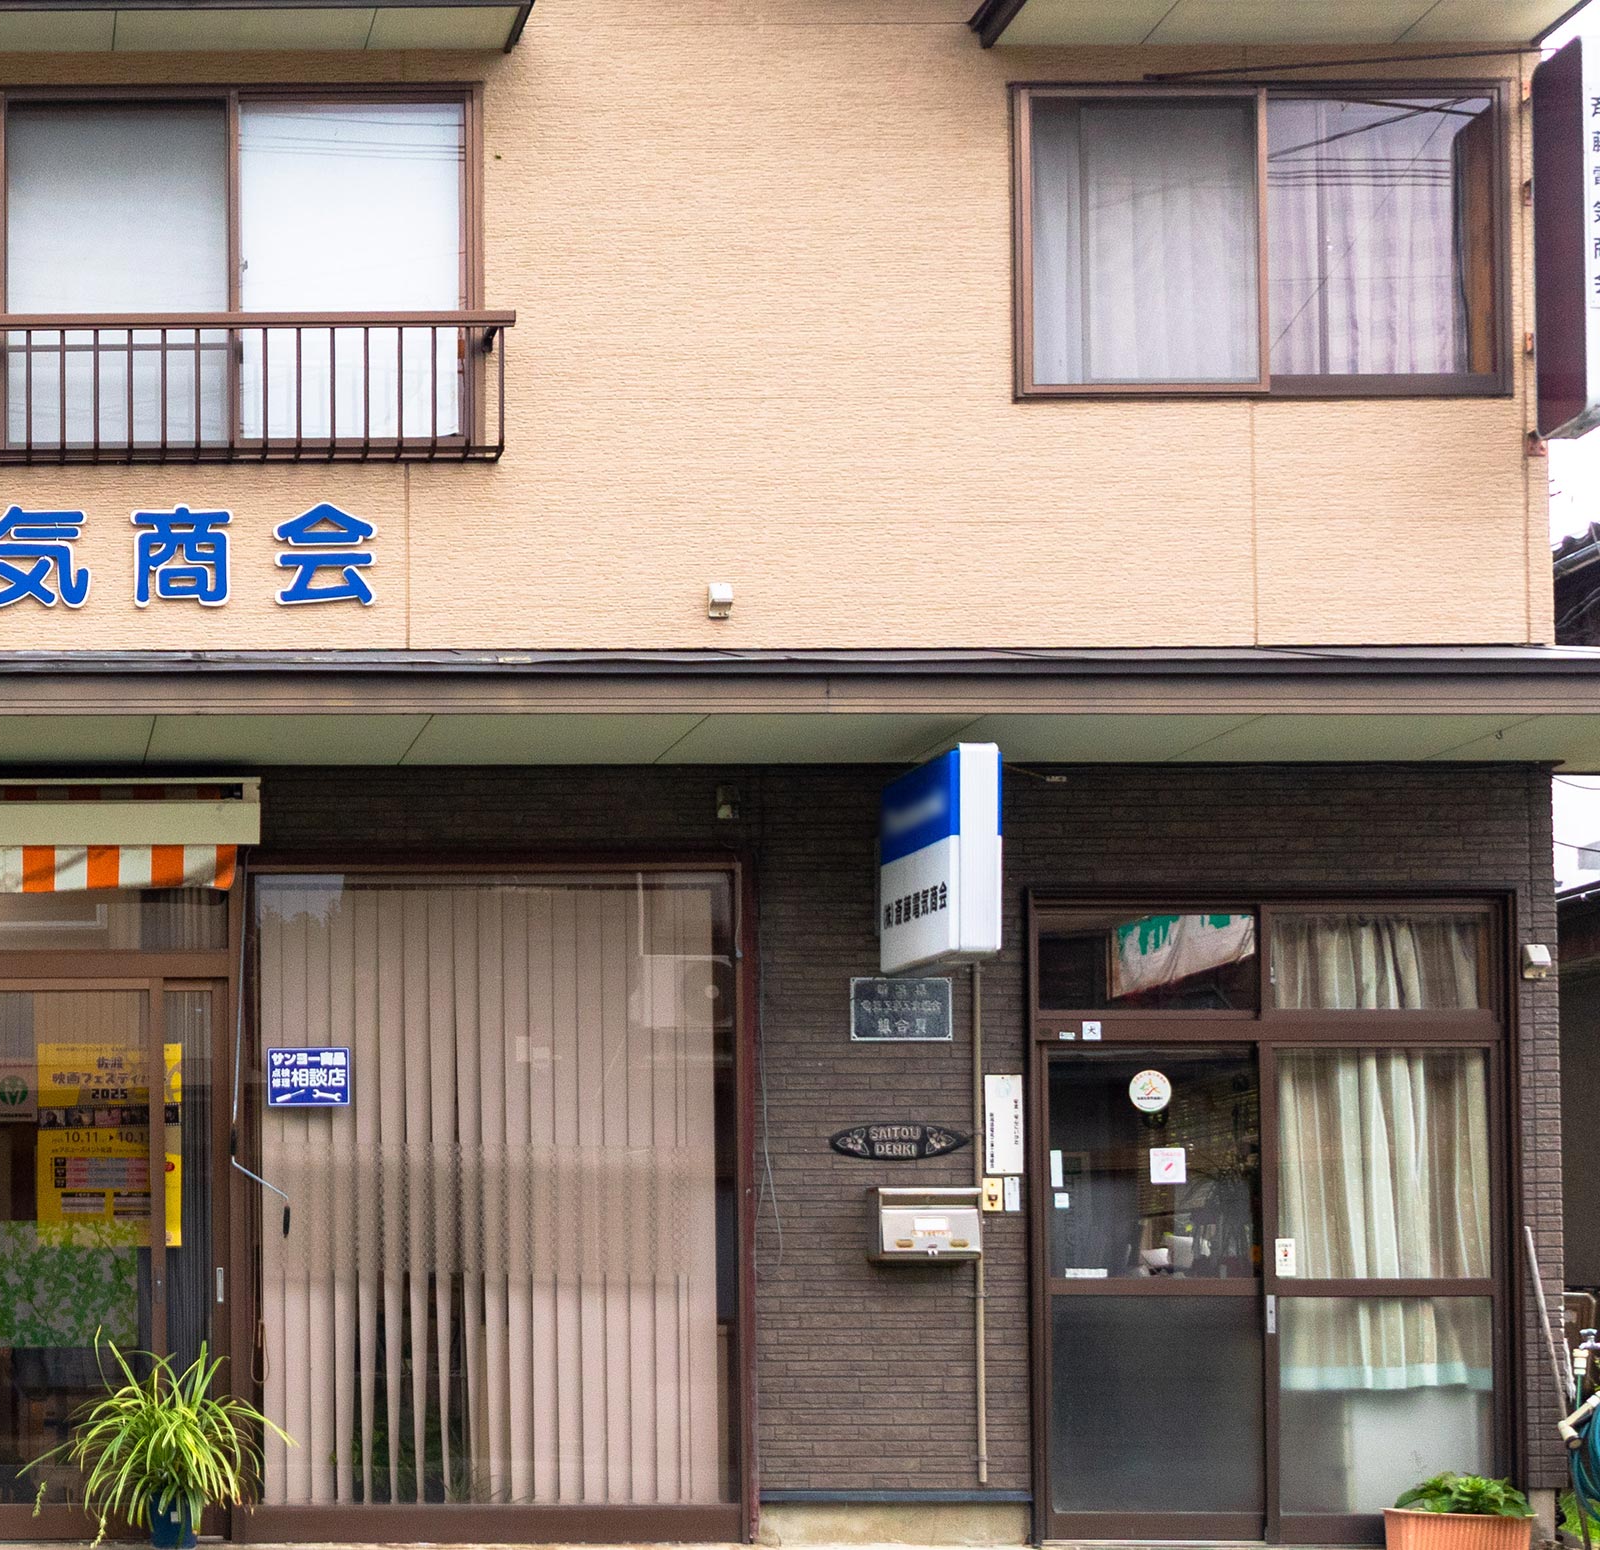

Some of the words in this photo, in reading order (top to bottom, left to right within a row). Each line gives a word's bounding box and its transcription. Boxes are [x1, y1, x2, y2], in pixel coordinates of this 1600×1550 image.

[271, 1051, 347, 1066] サンヨー商品
[291, 1067, 346, 1087] 相談店
[91, 1088, 129, 1100] 2025
[64, 1131, 99, 1143] 10.11
[119, 1131, 150, 1143] 10.1
[870, 1125, 921, 1140] SAITOU
[875, 1142, 917, 1156] DENKI
